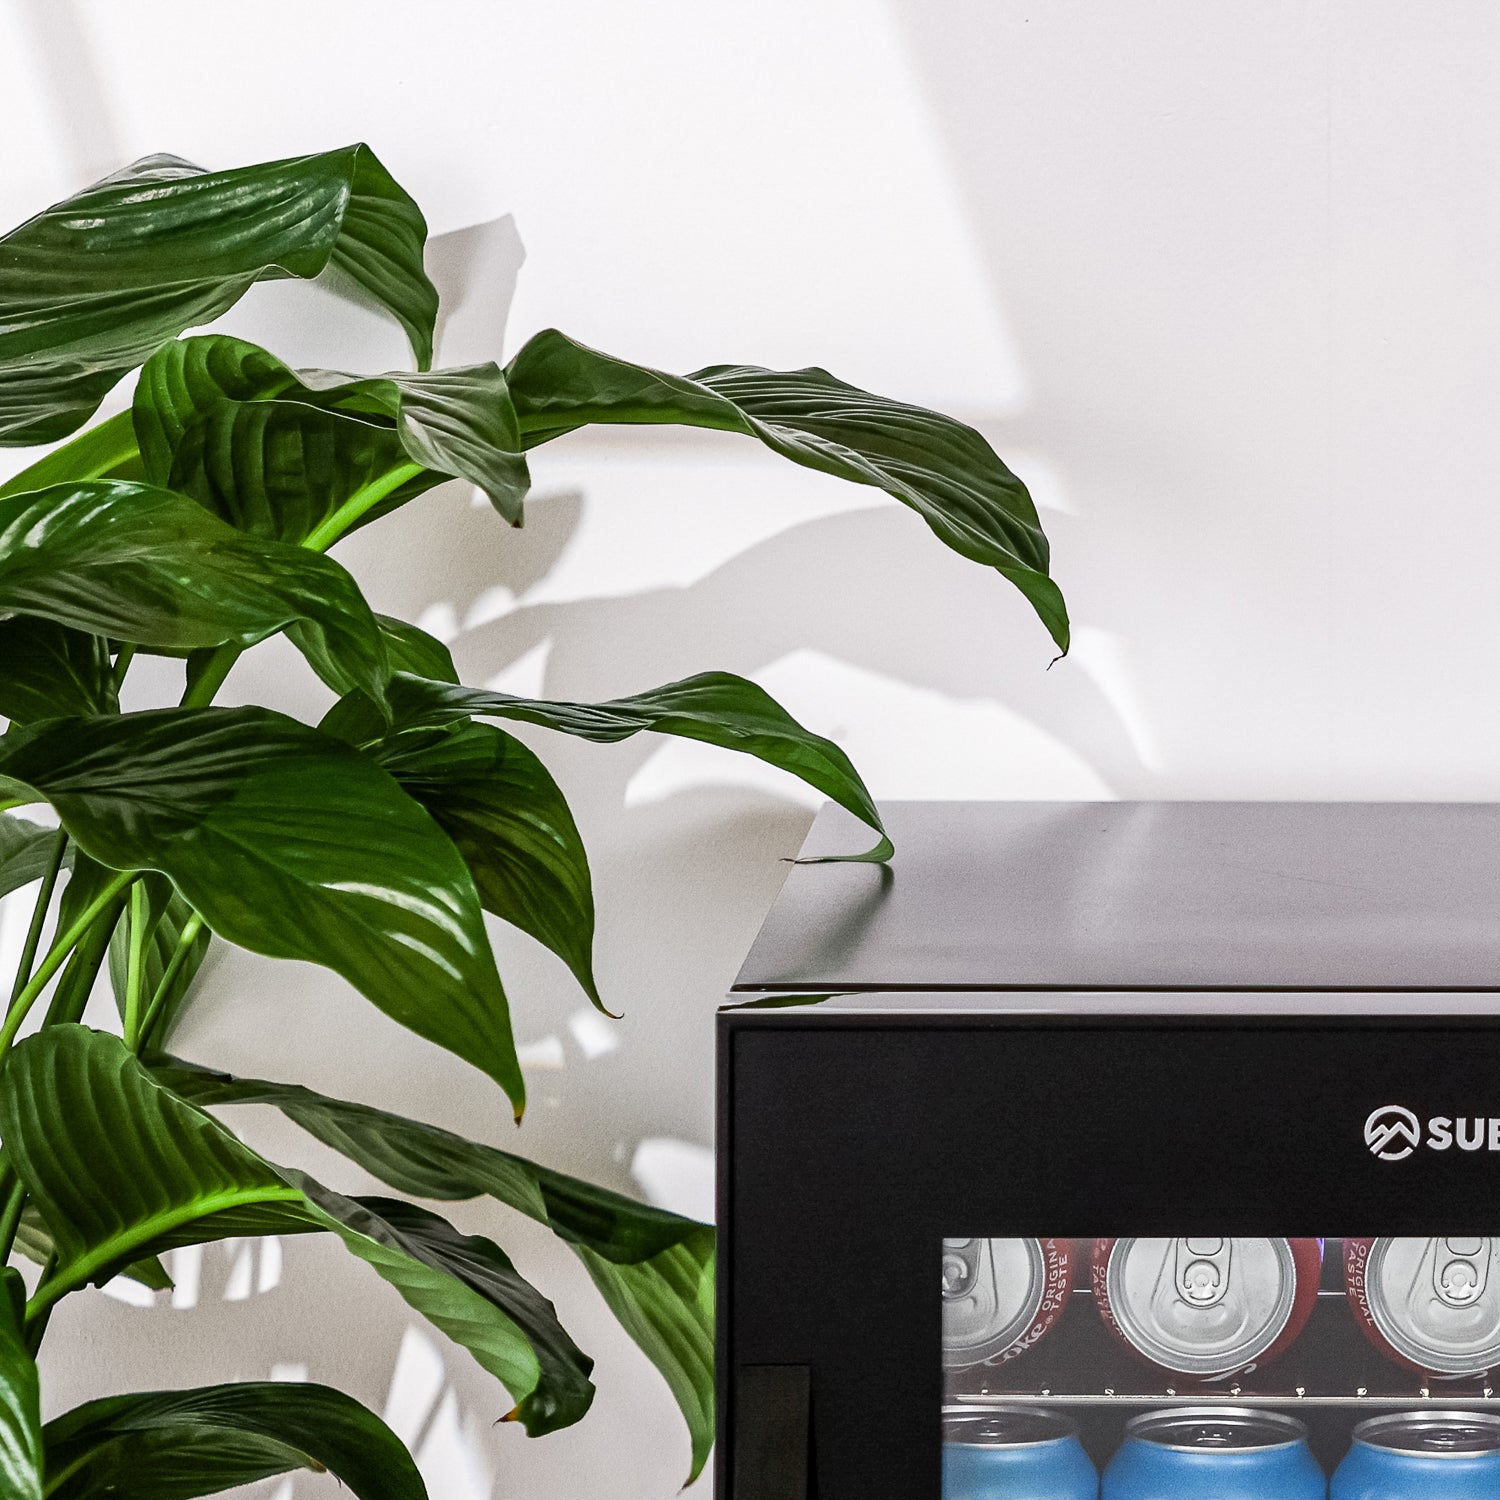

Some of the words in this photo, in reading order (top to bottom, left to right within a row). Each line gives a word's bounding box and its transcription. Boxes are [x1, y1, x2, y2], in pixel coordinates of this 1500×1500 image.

[1042, 1238, 1057, 1311] ORIGINA
[1050, 1254, 1068, 1311] TASTE
[1347, 1241, 1358, 1298] TASTE
[1354, 1244, 1375, 1326] ORIGINAL
